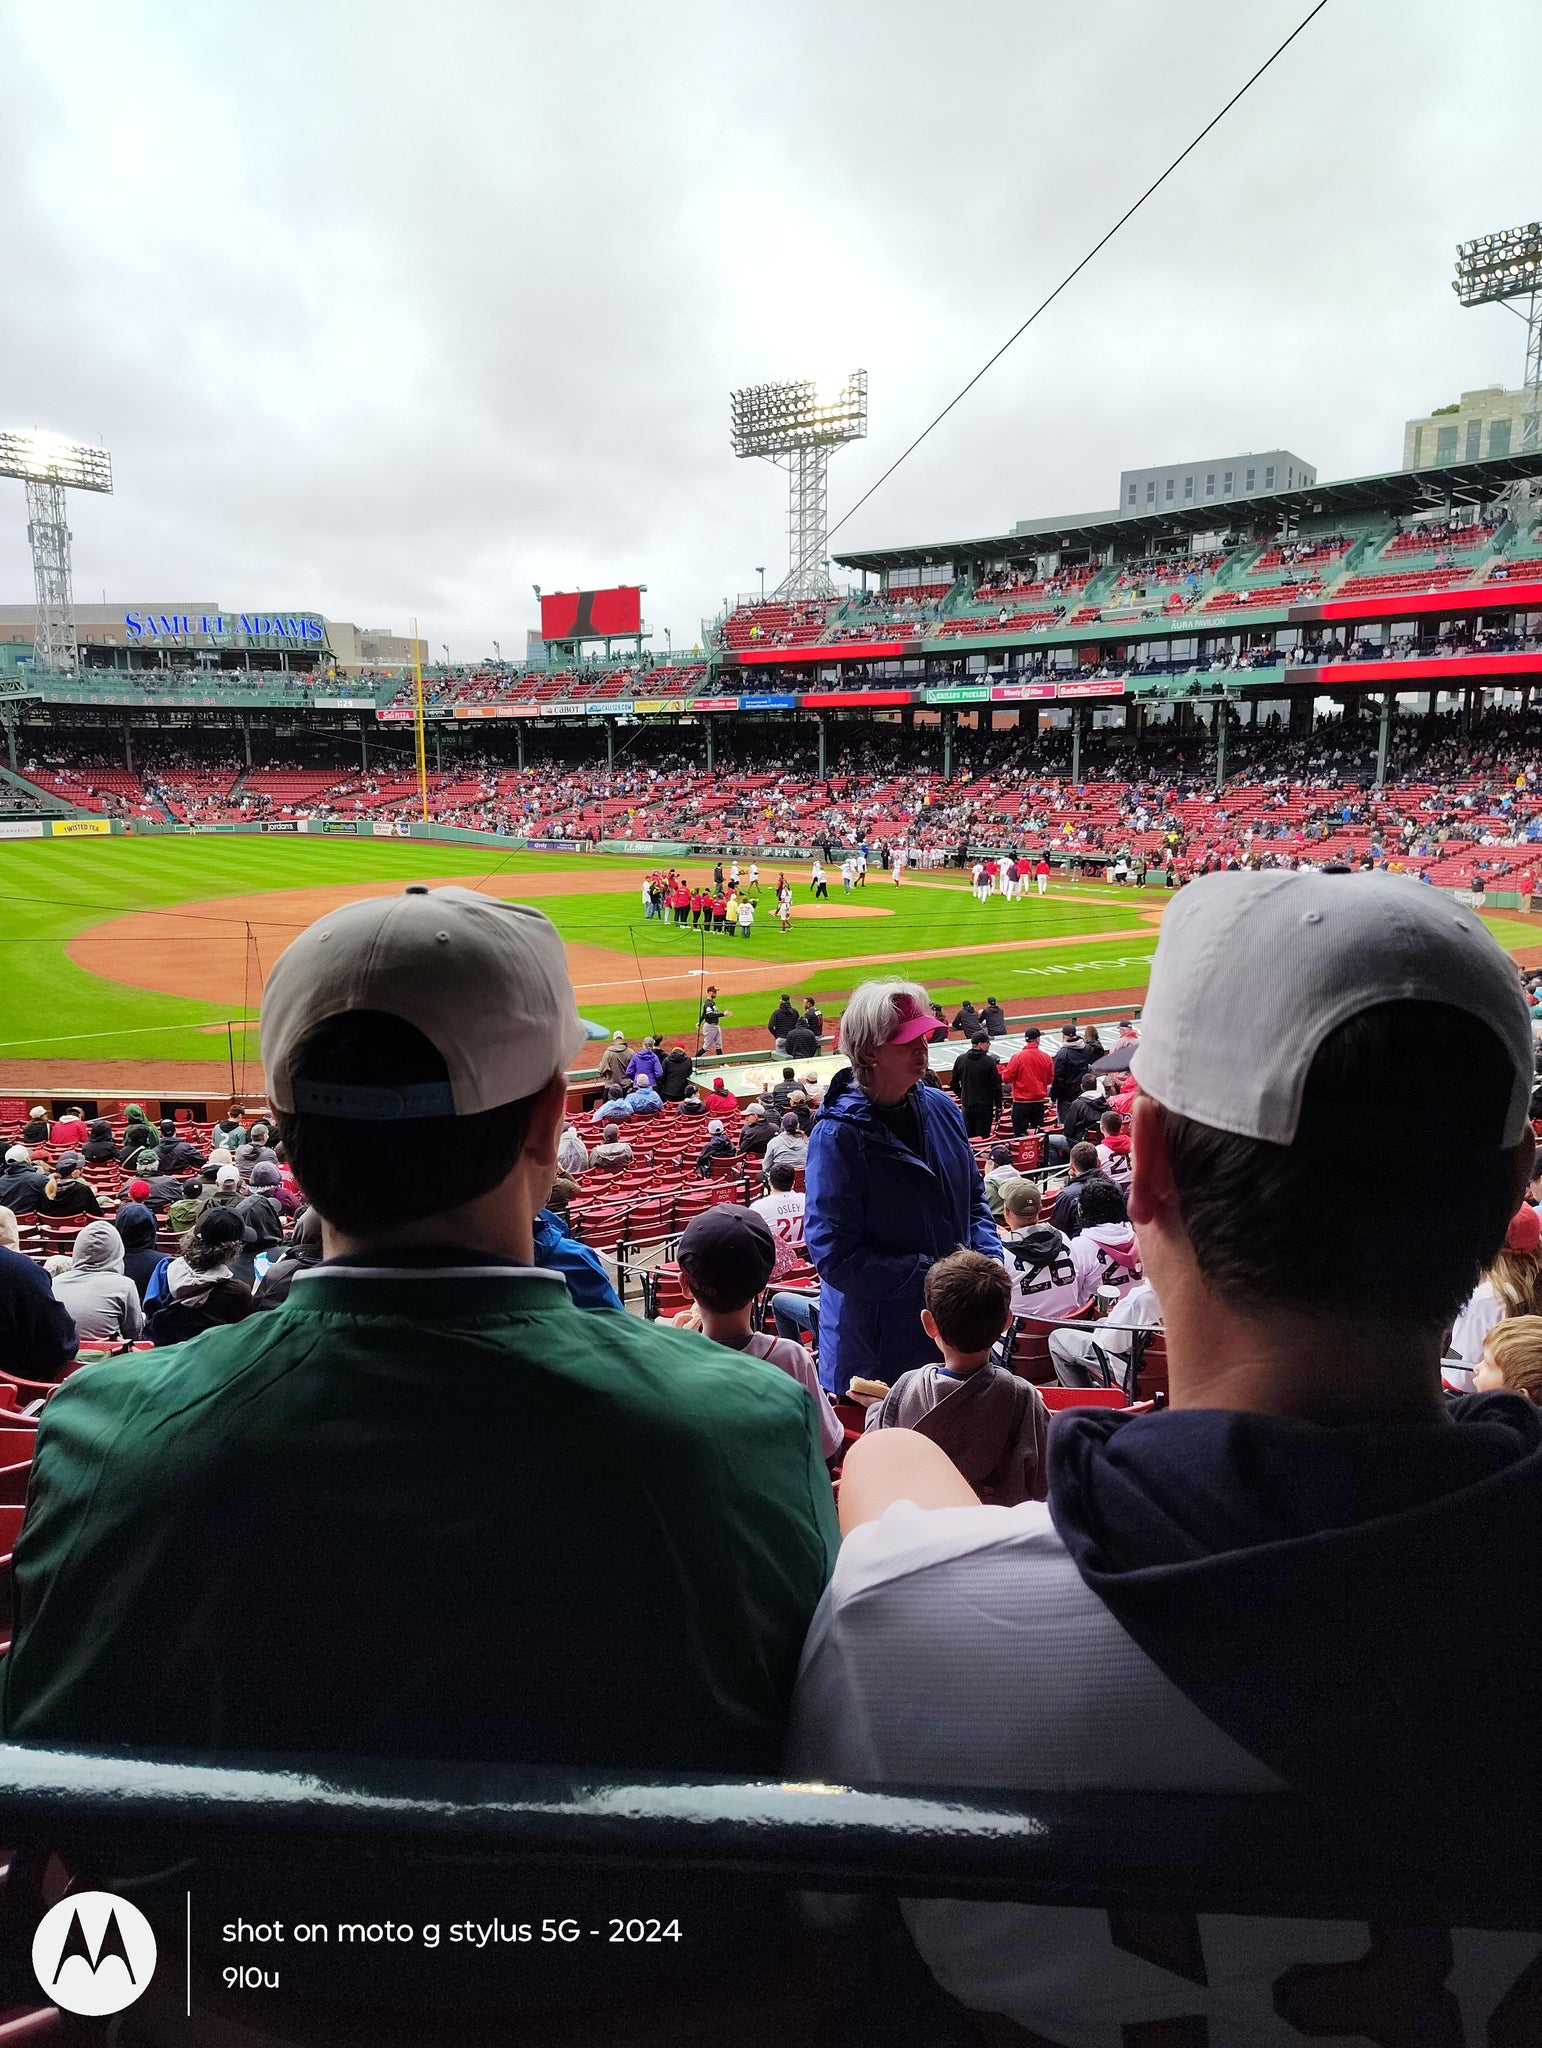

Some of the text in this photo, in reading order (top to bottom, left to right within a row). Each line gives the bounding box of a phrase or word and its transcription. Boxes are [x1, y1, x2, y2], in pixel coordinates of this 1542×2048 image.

[234, 613, 324, 642] ADAMS
[1194, 617, 1226, 628] PAVILION
[63, 824, 99, 833] TWISTED TEA
[219, 1132, 230, 1148] 2
[776, 1215, 805, 1243] 27
